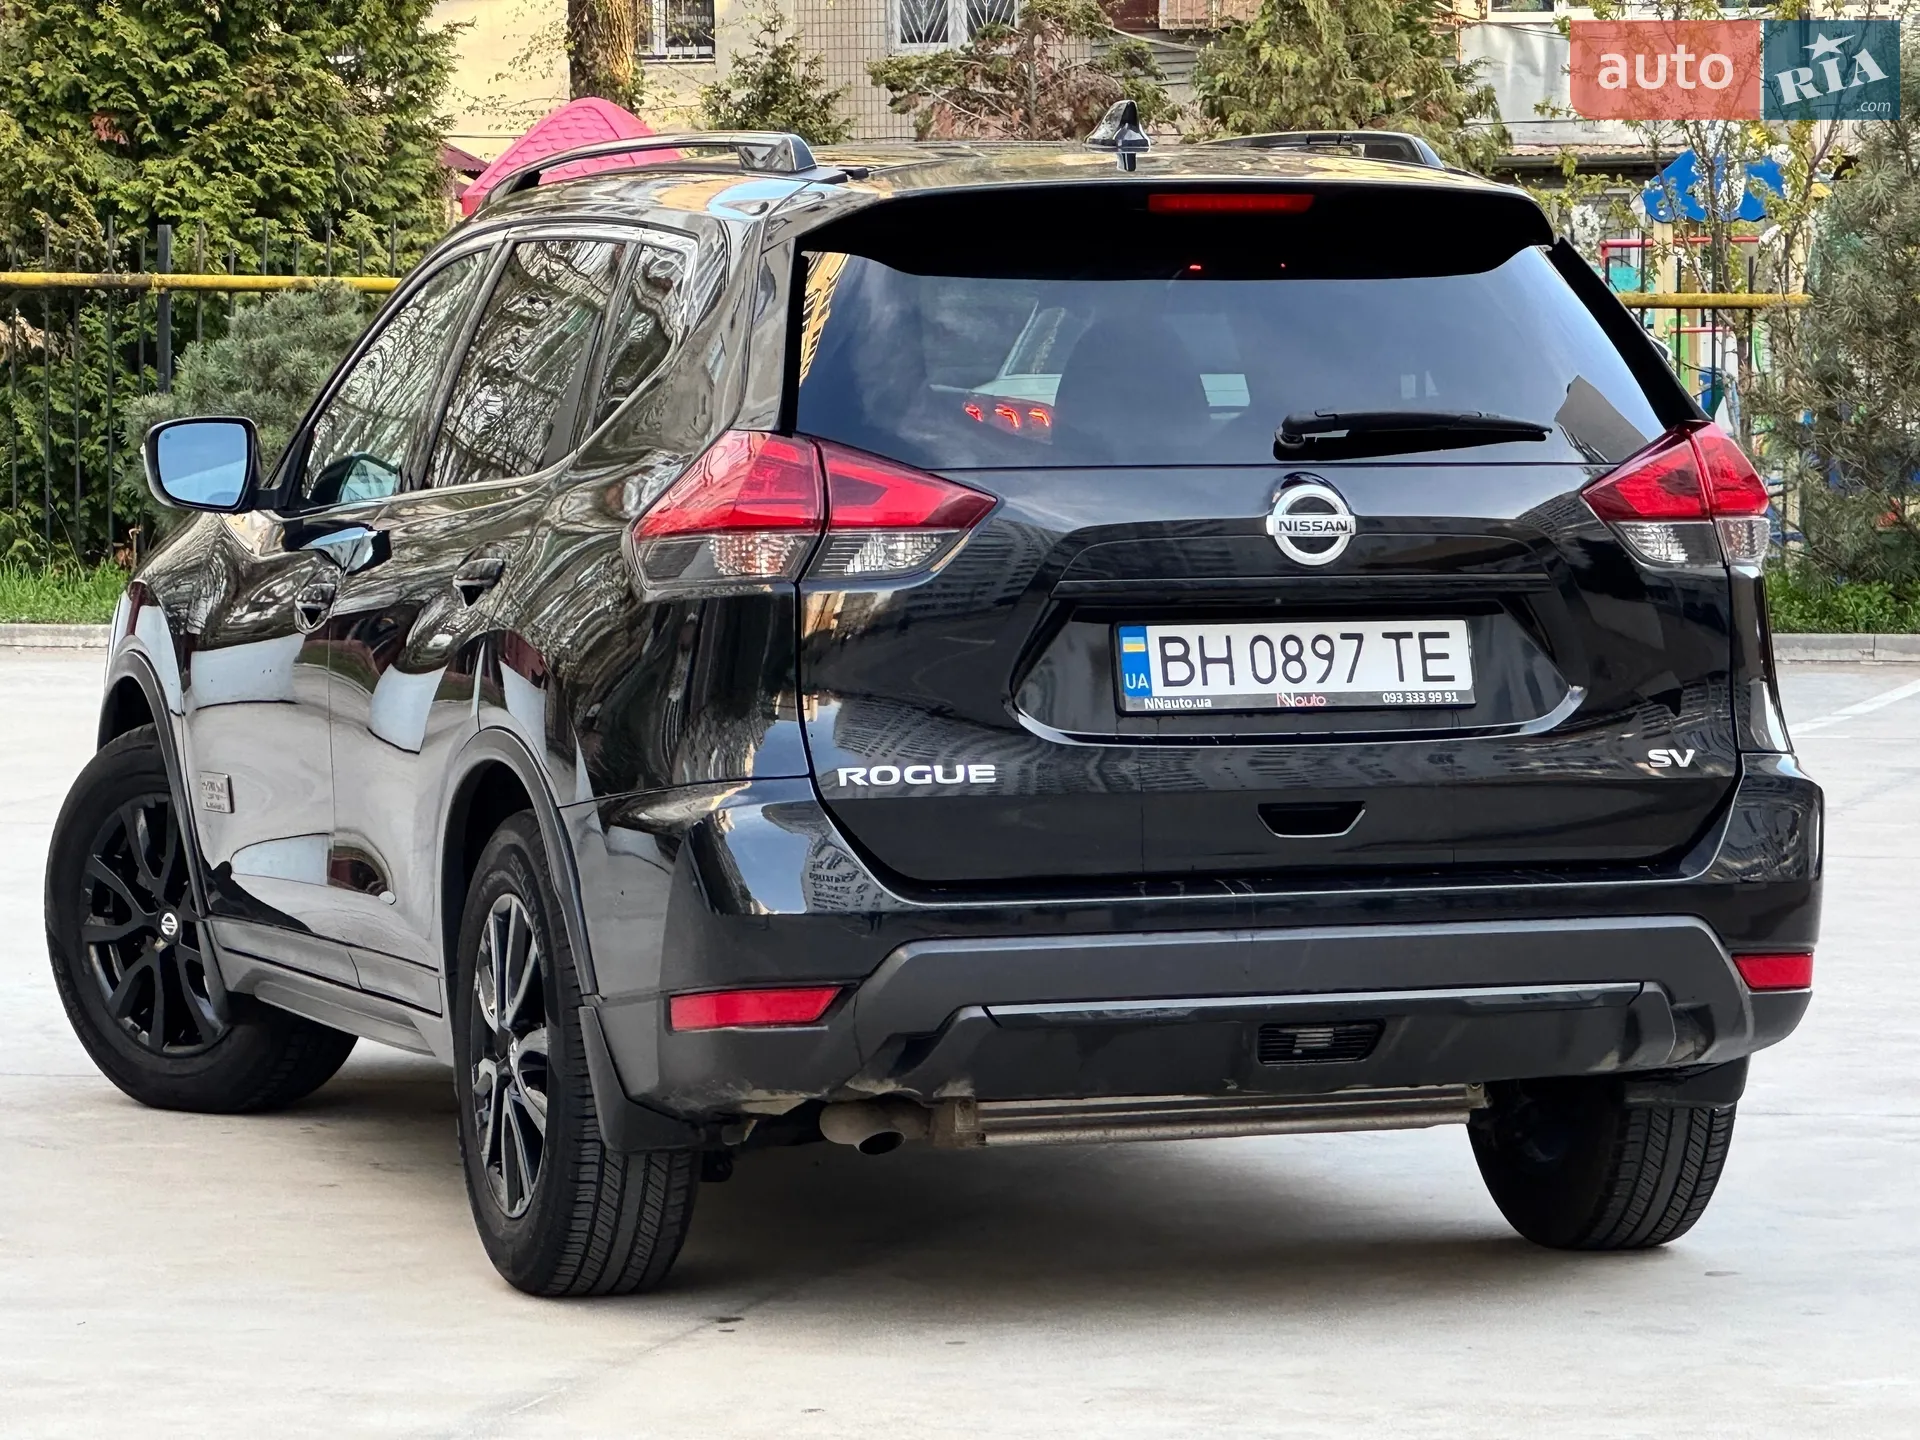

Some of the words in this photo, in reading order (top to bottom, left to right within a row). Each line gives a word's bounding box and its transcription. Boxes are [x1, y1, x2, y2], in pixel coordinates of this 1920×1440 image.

[1278, 520, 1348, 532] NISSAN
[1125, 673, 1149, 689] UA
[1158, 635, 1236, 687] BH
[1249, 632, 1364, 685] 0897
[1381, 631, 1456, 682] TE
[1144, 697, 1212, 710] NNauto.ua
[1382, 692, 1403, 703] 093
[1405, 692, 1427, 703] 333
[1428, 691, 1442, 702] 99
[1444, 691, 1459, 702] 91
[1647, 748, 1696, 768] SV
[836, 764, 997, 787] ROGUE
